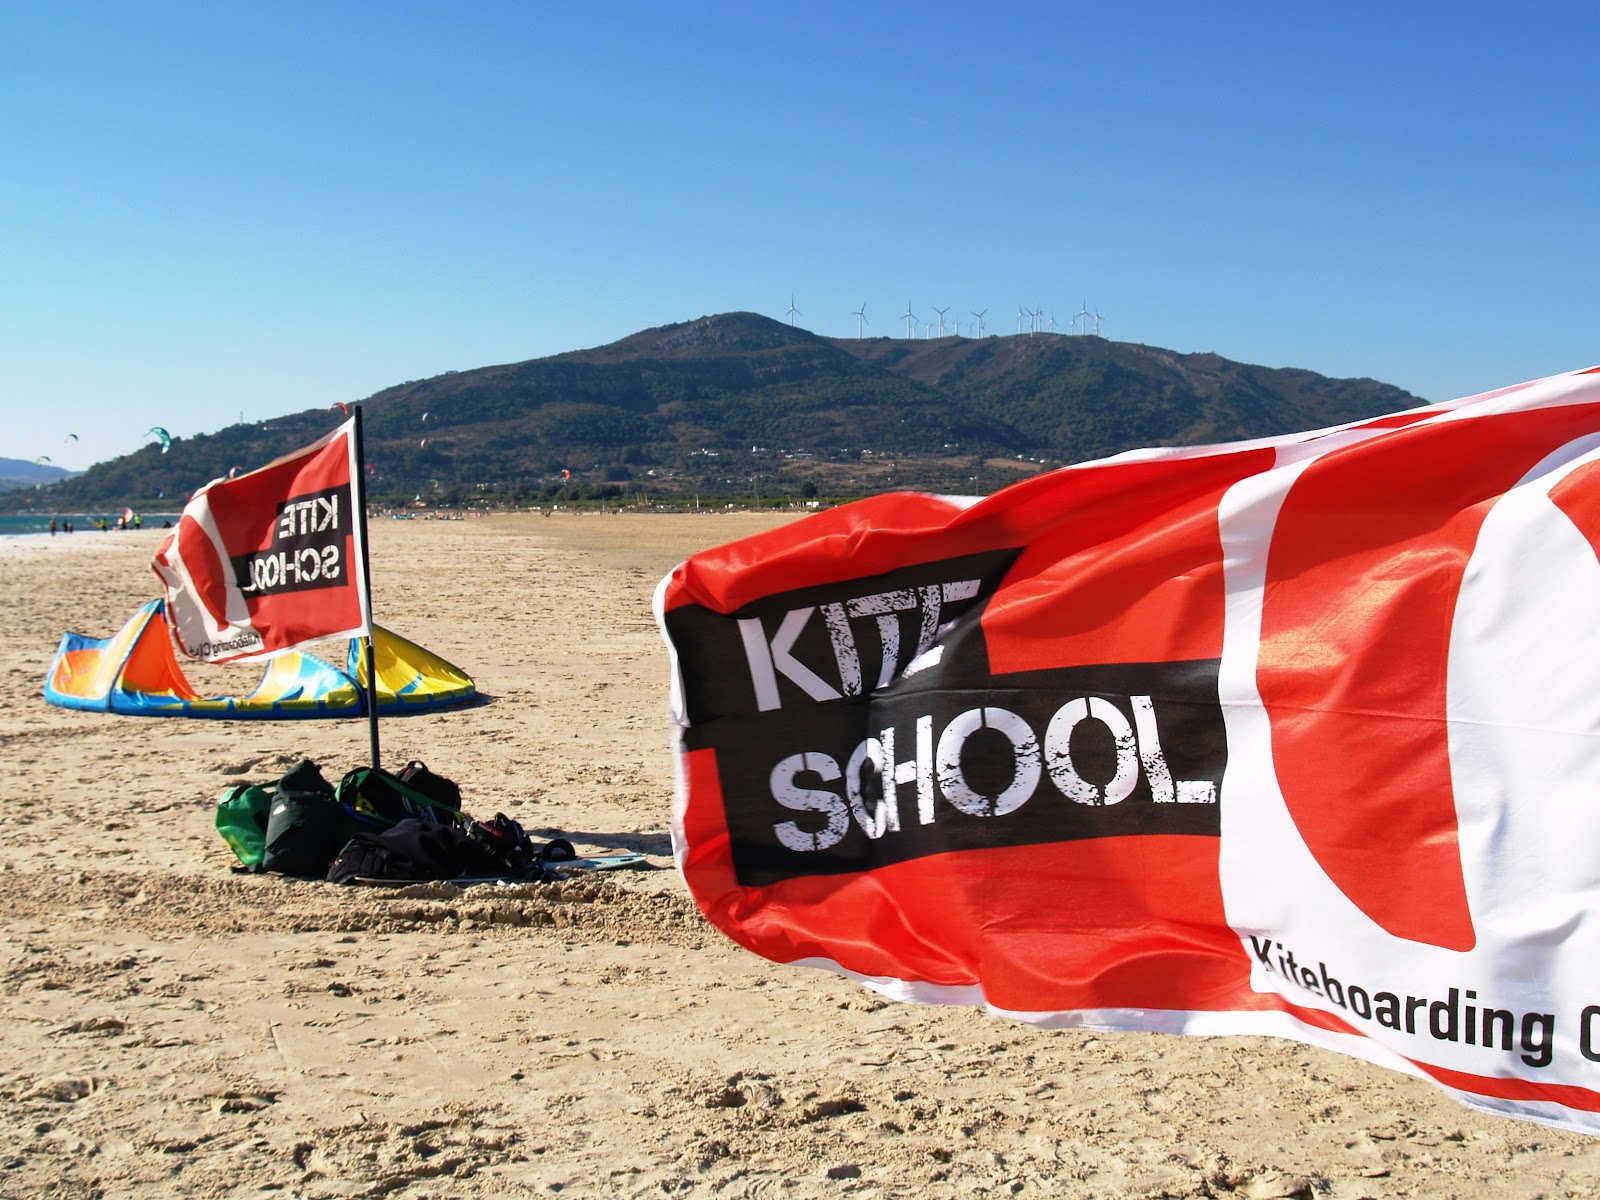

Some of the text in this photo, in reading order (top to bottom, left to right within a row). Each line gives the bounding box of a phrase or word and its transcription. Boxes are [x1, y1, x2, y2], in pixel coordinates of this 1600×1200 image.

[738, 578, 982, 712] KITE
[769, 695, 1217, 852] SCHOOL
[1249, 935, 1555, 1068] Kiteboarding
